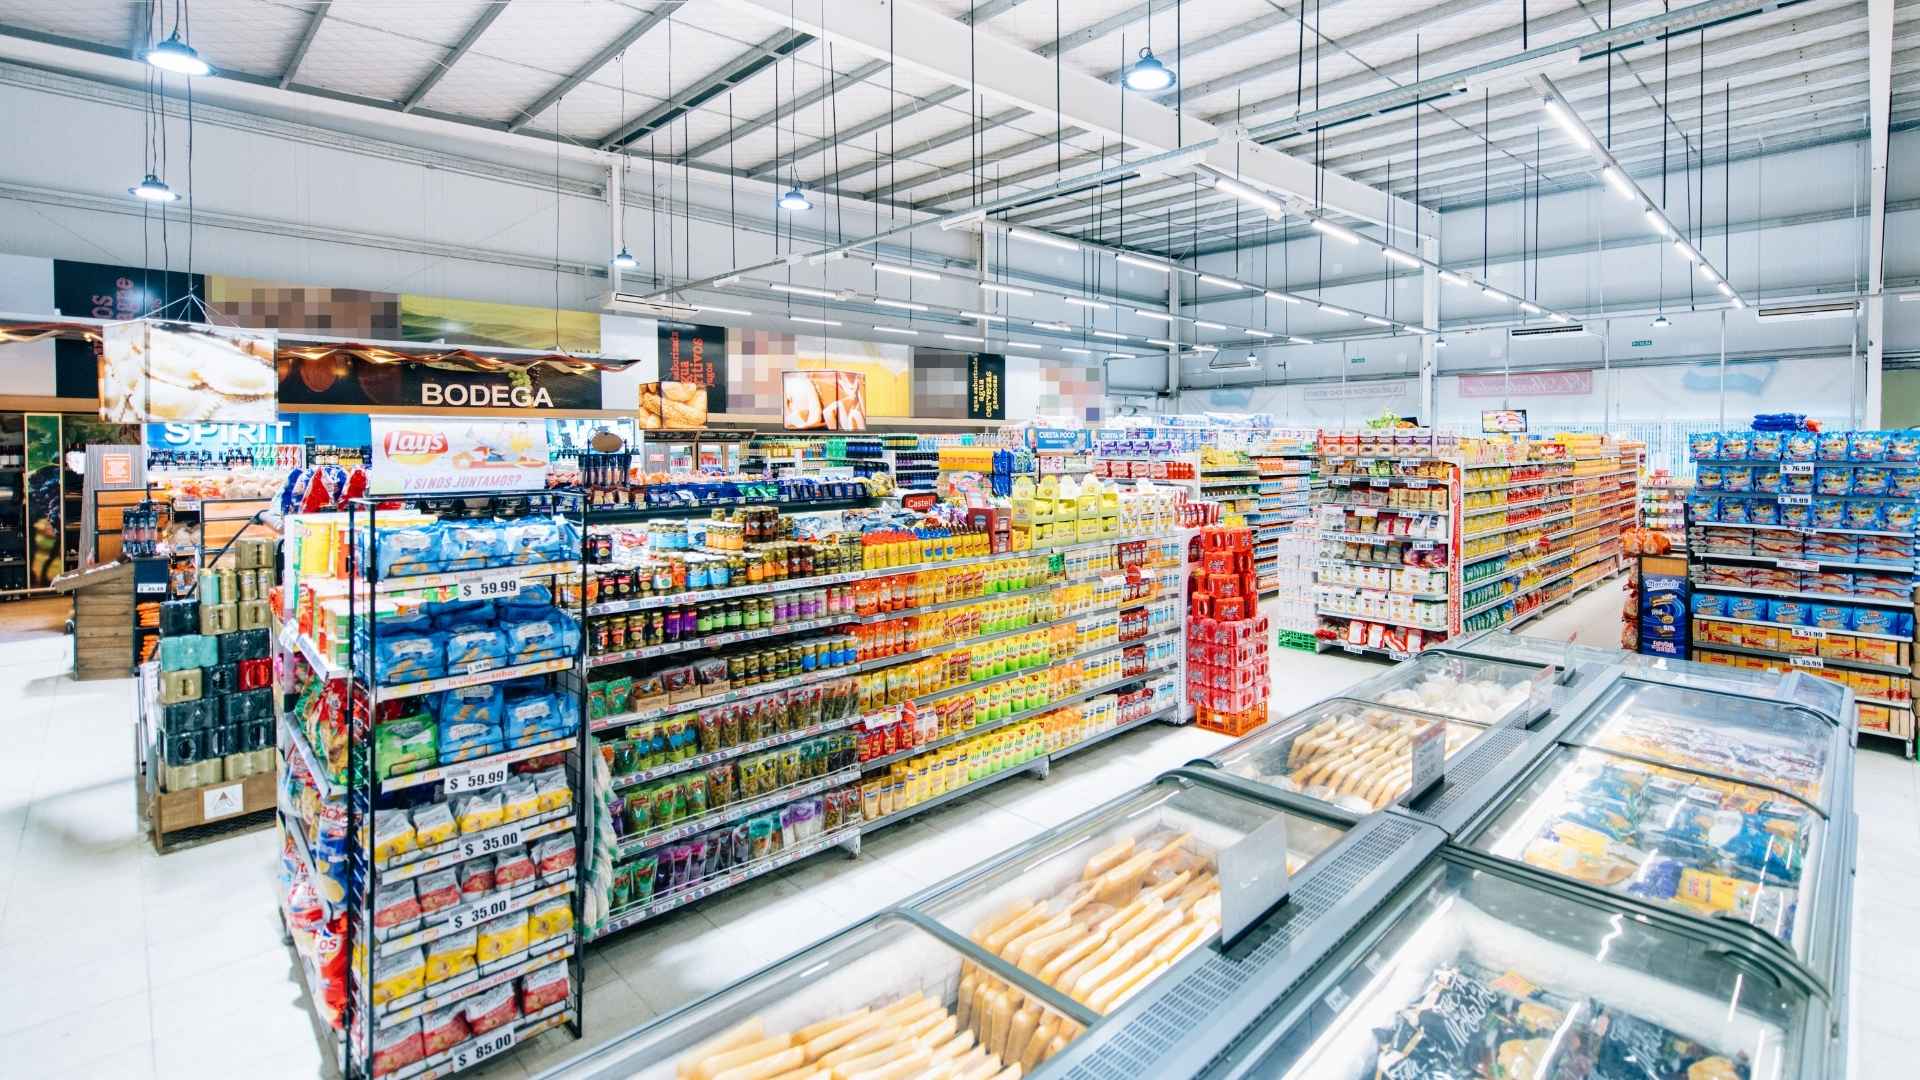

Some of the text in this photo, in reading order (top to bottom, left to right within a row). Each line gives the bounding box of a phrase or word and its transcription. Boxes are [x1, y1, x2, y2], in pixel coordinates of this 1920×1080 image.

[421, 382, 554, 408] BODEGA
[164, 421, 291, 446] SPIRIT
[463, 580, 517, 597] $ 59.99
[450, 769, 504, 790] $ 59.99
[465, 832, 518, 856] $ 35.00
[454, 899, 507, 928] $ 35.00
[458, 1033, 511, 1067] $ 85.00
